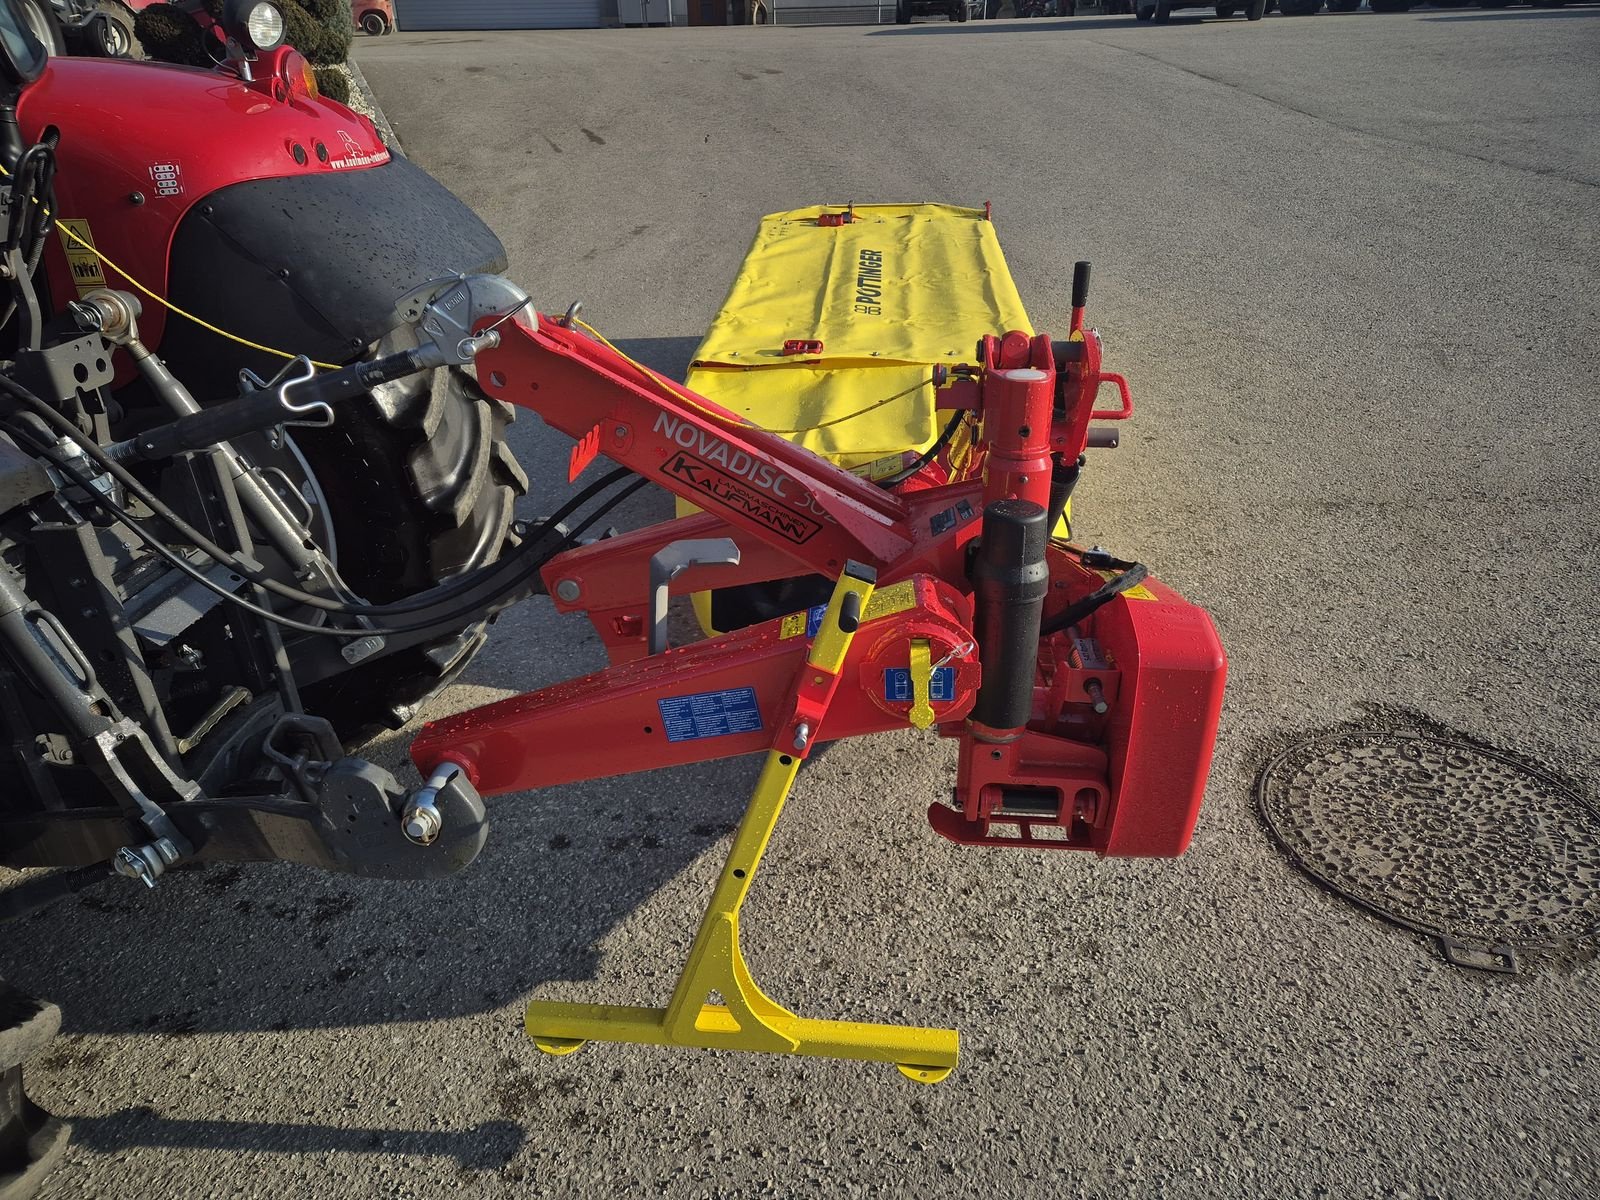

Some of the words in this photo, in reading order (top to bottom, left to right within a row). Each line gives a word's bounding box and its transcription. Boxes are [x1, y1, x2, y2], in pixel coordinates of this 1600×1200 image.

[653, 411, 793, 497] NOVADISC
[672, 457, 805, 539] KAUFMANN
[718, 478, 808, 530] LANDMASCHINEN
